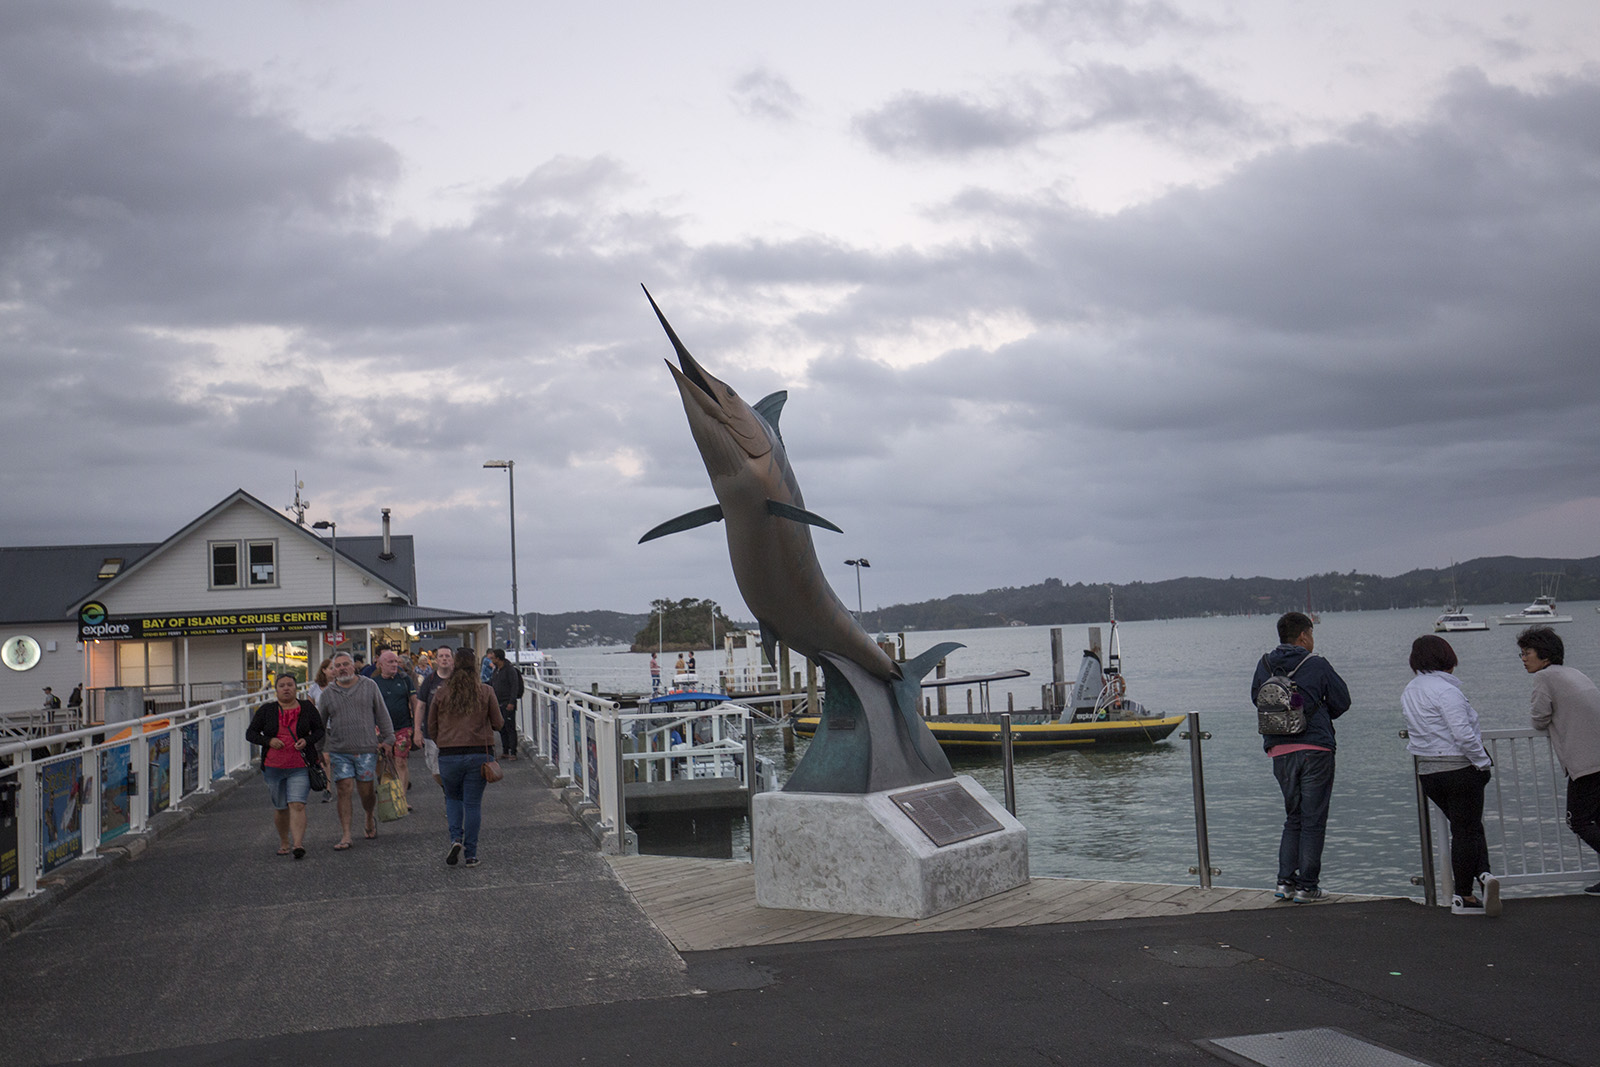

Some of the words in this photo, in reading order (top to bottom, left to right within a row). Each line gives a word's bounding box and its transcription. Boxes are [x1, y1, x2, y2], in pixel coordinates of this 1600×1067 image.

[142, 618, 167, 629] BAY
[168, 618, 185, 628] OF
[187, 615, 237, 627] ISLANDS
[239, 613, 281, 624] CRUISE
[282, 611, 327, 622] CENTRE
[82, 623, 130, 636] explore
